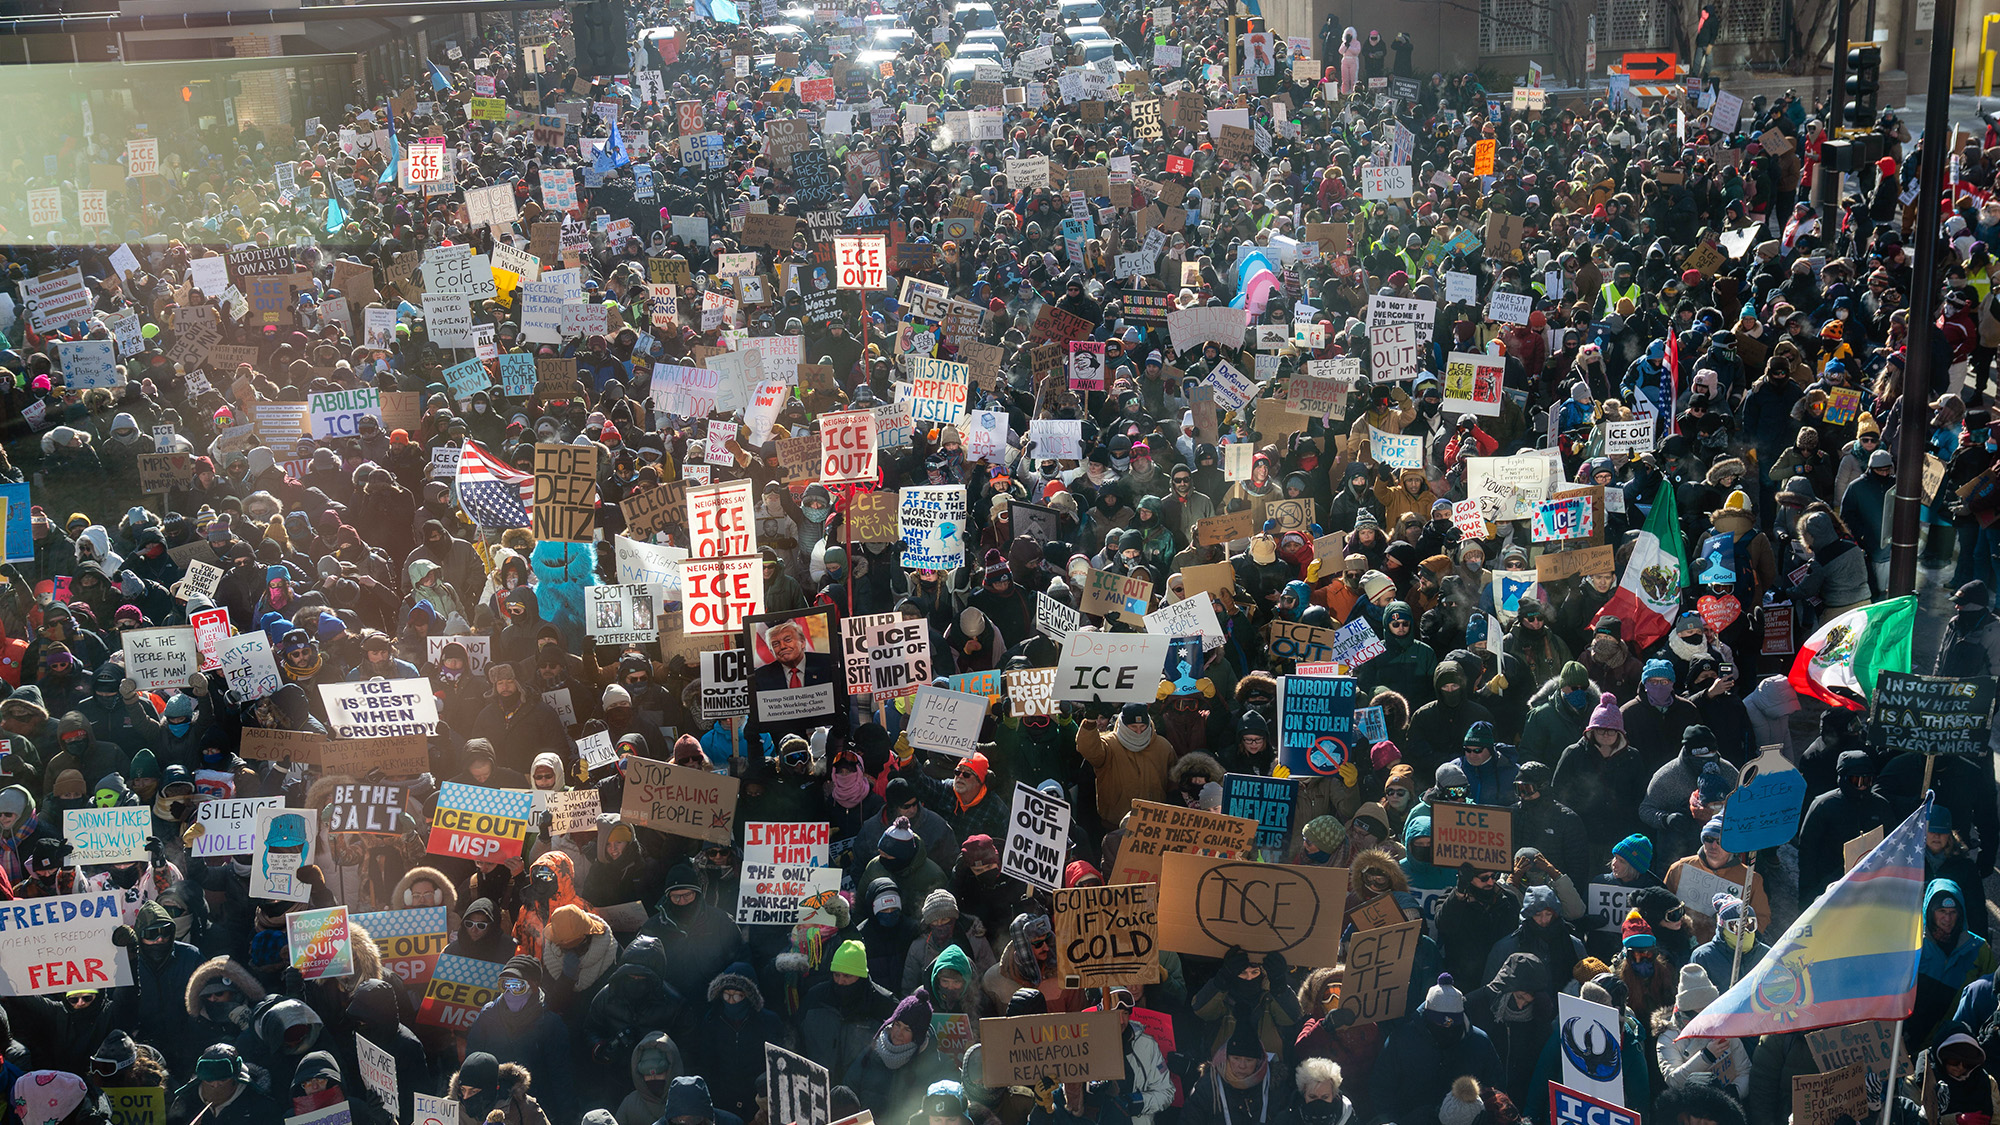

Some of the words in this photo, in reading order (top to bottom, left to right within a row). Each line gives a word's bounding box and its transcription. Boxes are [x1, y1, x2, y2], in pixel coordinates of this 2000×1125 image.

[1134, 102, 1160, 115] ICE
[539, 116, 560, 128] ICE
[1135, 114, 1161, 127] OUT
[533, 130, 564, 144] OUT
[770, 123, 794, 136] NO
[1136, 126, 1162, 136] NOW
[771, 132, 808, 146] IMMUNITY
[132, 149, 154, 160] ICE
[782, 142, 802, 154] FOR
[412, 155, 436, 168] ICE
[792, 152, 826, 164] FUCK
[131, 161, 156, 173] OUT!
[412, 169, 439, 180] OUT!
[795, 164, 826, 176] THESE
[1366, 168, 1398, 178] MICRO
[797, 175, 830, 188] TEMU
[1368, 179, 1405, 192] PENIS
[795, 186, 832, 200] FASCISTS
[32, 198, 56, 210] ICE
[82, 198, 104, 210] ICE
[33, 210, 59, 224] OUT!
[83, 211, 106, 224] OUT!
[650, 260, 686, 273] DEPORT
[842, 250, 878, 268] ICE
[659, 272, 678, 284] ICE
[844, 269, 883, 287] OUT!
[25, 280, 68, 296] INVADING
[655, 287, 670, 296] NO
[26, 290, 90, 312] COMMUNITIES
[1123, 295, 1132, 304] ICE
[1134, 296, 1145, 305] OUT
[1146, 296, 1153, 306] OF
[1154, 297, 1167, 306] OUR
[1491, 301, 1529, 314] JONATHAN
[1494, 294, 1526, 305] ARREST
[32, 308, 92, 329] EVERYWHERE
[652, 306, 676, 314] KING
[1498, 312, 1518, 322] ROSS
[654, 316, 673, 324] WAY
[1372, 327, 1406, 346] ICE
[1373, 347, 1414, 367] OUT
[447, 369, 465, 383] ICE
[466, 361, 482, 377] OUT
[915, 359, 968, 384] HISTORY
[1378, 369, 1391, 379] OF
[1400, 364, 1417, 376] MN
[914, 380, 968, 402] REPEATS
[912, 399, 962, 423] ITSELF
[825, 426, 868, 451] ICE
[1609, 429, 1626, 439] ICE
[1630, 426, 1650, 438] OUT
[1618, 438, 1650, 446] MINNESOTA
[537, 448, 591, 476] ICE
[824, 453, 872, 476] OUT!
[536, 476, 596, 507] DEEZ
[1542, 500, 1580, 512] ABOLISH
[534, 506, 594, 540] NUTZ
[1552, 510, 1576, 530] ICE
[594, 586, 623, 599] SPOT
[626, 584, 648, 596] THE
[132, 638, 151, 648] WE
[156, 636, 176, 646] THE
[598, 633, 651, 643] DIFFERENCE
[877, 626, 920, 646] ICE
[872, 647, 902, 660] OUT
[907, 643, 926, 653] OF
[1070, 634, 1149, 662] Deport
[136, 668, 158, 678] THE
[164, 664, 186, 678] MAN!
[875, 660, 927, 688] MPLS
[1070, 666, 1138, 689] ICE
[361, 682, 392, 694] ICE
[1288, 679, 1337, 696] NOBODY
[1340, 682, 1352, 696] IS
[1886, 677, 1977, 697] INJUSTICE
[342, 698, 359, 710] IS
[366, 694, 414, 708] BEST
[784, 699, 824, 708] Working-Class
[796, 706, 826, 714] Pedophiles
[1287, 698, 1329, 713] ILLEGAL
[352, 709, 414, 723] WHEN
[1286, 715, 1302, 729] ON
[1306, 716, 1349, 732] STOLEN
[1880, 708, 1897, 722] IS
[1902, 712, 1916, 726] A
[1922, 714, 1984, 729] THREAT
[340, 724, 434, 737] CRUSHED!
[1882, 725, 1902, 735] TO
[1910, 726, 1970, 740] JUSTICE
[1284, 734, 1316, 748] LAND
[1886, 736, 1982, 753] EVERYWHERE
[629, 764, 671, 786] STOP
[336, 786, 353, 804] BE
[360, 786, 400, 805] THE
[640, 785, 718, 804] STEALING
[651, 802, 703, 826] PEOPLE
[1024, 794, 1058, 822] ICE
[67, 810, 150, 831] SNOWFLAKES
[330, 806, 401, 831] SALT
[434, 809, 472, 831] ICE
[476, 815, 524, 837] OUT
[1017, 811, 1062, 840] OUT
[1456, 811, 1489, 828] ICE
[747, 824, 828, 845] IMPEACH
[1439, 828, 1504, 846] MURDERS
[448, 834, 500, 857] MSP
[1013, 834, 1033, 854] OF
[1034, 842, 1060, 866] MN
[1436, 845, 1506, 864] AMERICANS
[1007, 850, 1058, 883] NOW
[1055, 890, 1080, 913] GO
[1086, 886, 1147, 909] HOME
[0, 895, 118, 932] FREEDOM
[1076, 912, 1098, 935] IF
[1067, 930, 1152, 964] COLD
[1352, 928, 1414, 970] GET
[28, 958, 108, 990] FEAR
[1352, 965, 1392, 991] TF
[1347, 988, 1398, 1020] OUT
[1013, 1028, 1025, 1042] A
[1030, 1023, 1089, 1043] UNIQUE
[1010, 1044, 1089, 1063] MINNEAPOLIS
[1014, 1063, 1090, 1080] REACTION
